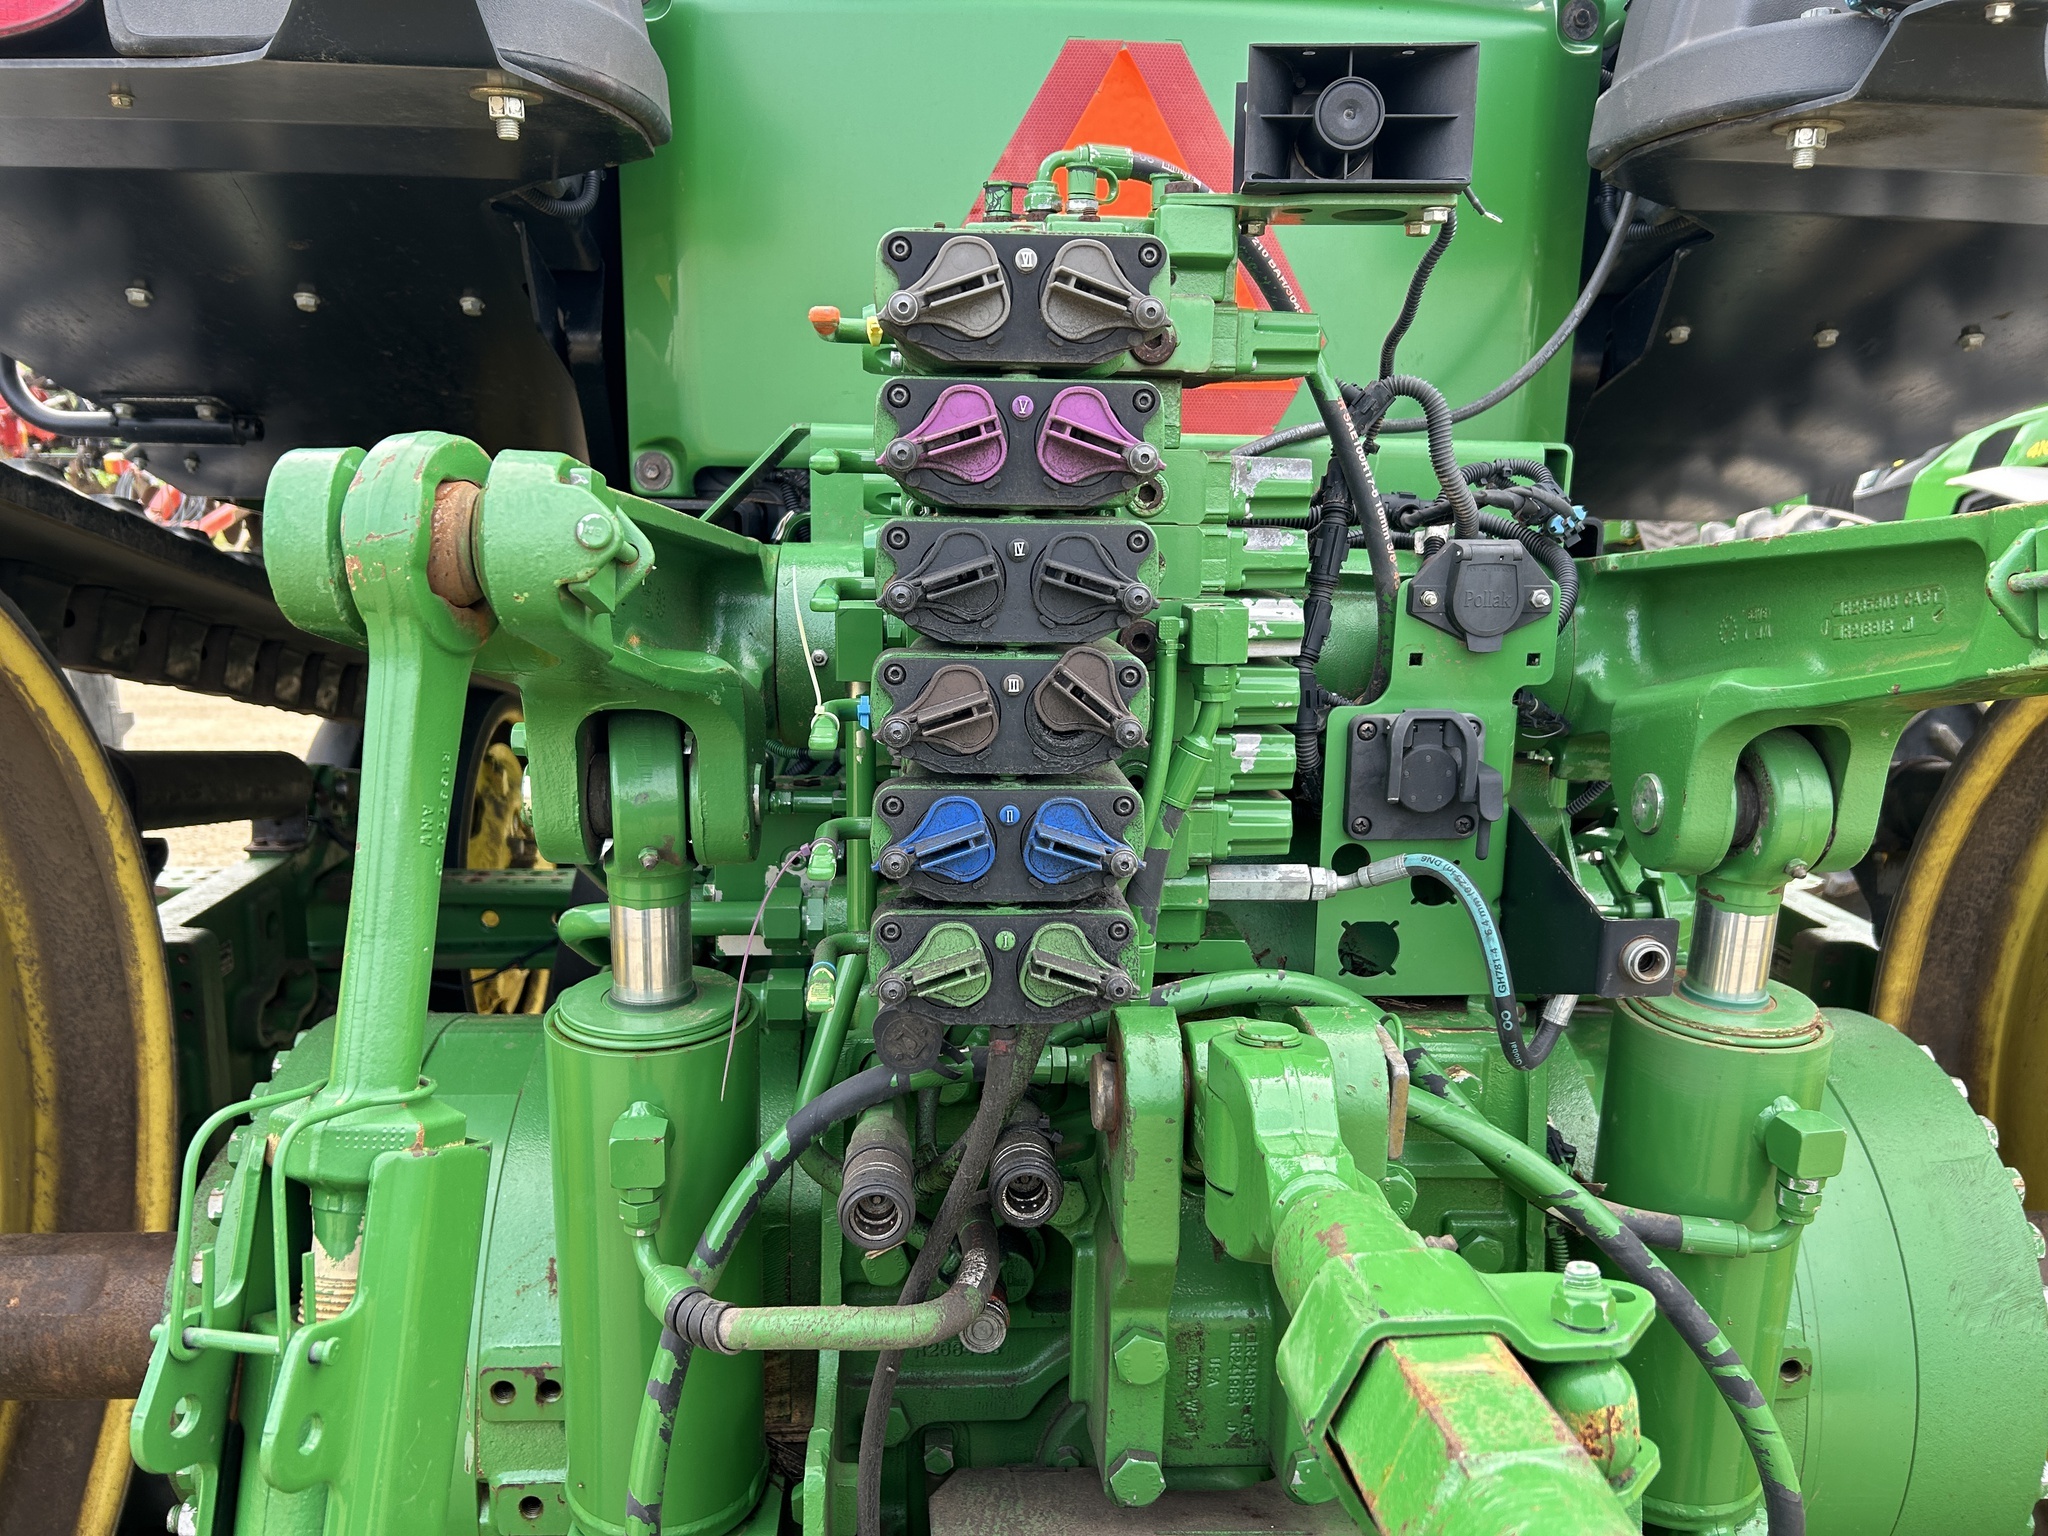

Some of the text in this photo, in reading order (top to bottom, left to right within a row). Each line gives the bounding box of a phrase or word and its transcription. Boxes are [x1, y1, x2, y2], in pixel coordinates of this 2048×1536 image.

[1251, 236, 1269, 258] 210
[1020, 251, 1034, 268] VI
[1018, 399, 1030, 414] V
[1374, 501, 1390, 541] 10mm
[1013, 541, 1026, 557] IV
[1463, 589, 1513, 609] Pollak
[1007, 678, 1020, 693] III
[1005, 809, 1014, 823] II
[1420, 855, 1443, 867] DN6
[1473, 897, 1487, 918] mm
[1490, 947, 1507, 994] GH781-4
[1206, 1357, 1221, 1388] USA
